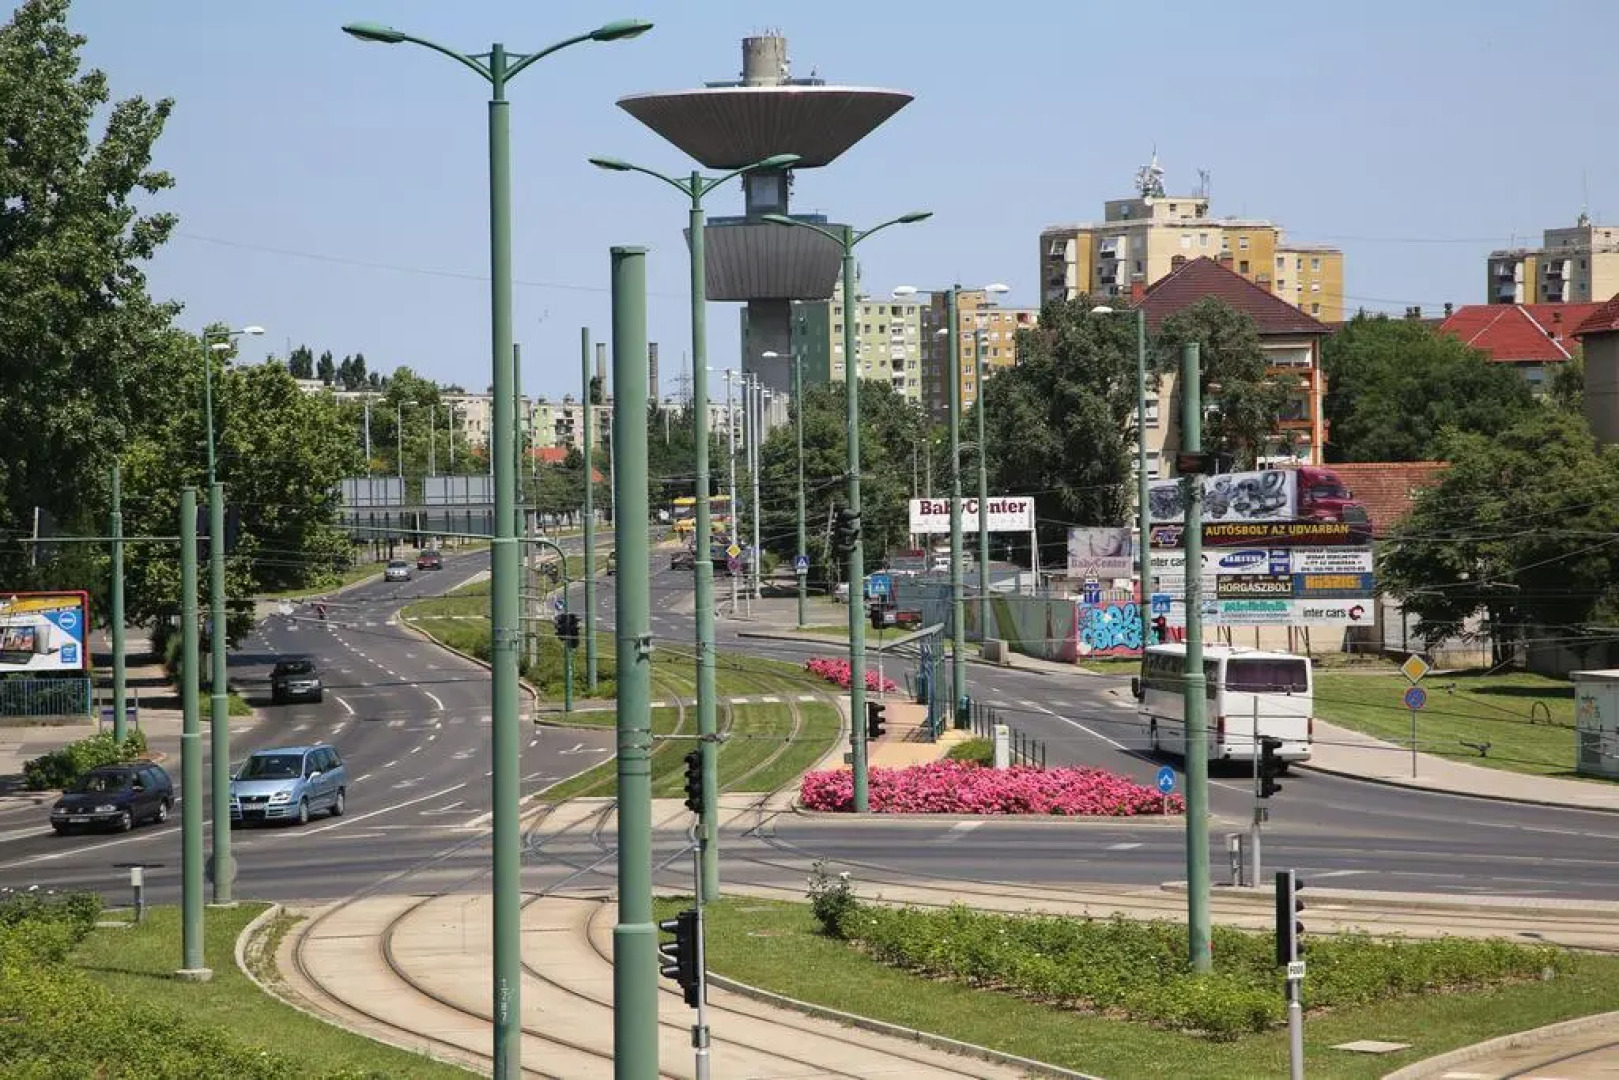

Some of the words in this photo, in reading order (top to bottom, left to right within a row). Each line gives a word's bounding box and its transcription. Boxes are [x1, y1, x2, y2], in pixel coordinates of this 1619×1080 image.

[1205, 524, 1268, 536] AUTÓSBOLT
[1271, 525, 1285, 535] AZ
[1288, 524, 1349, 536] UDVARBAN
[1151, 557, 1168, 566] nter
[1303, 607, 1324, 618] inter
[1326, 608, 1346, 618] cars
